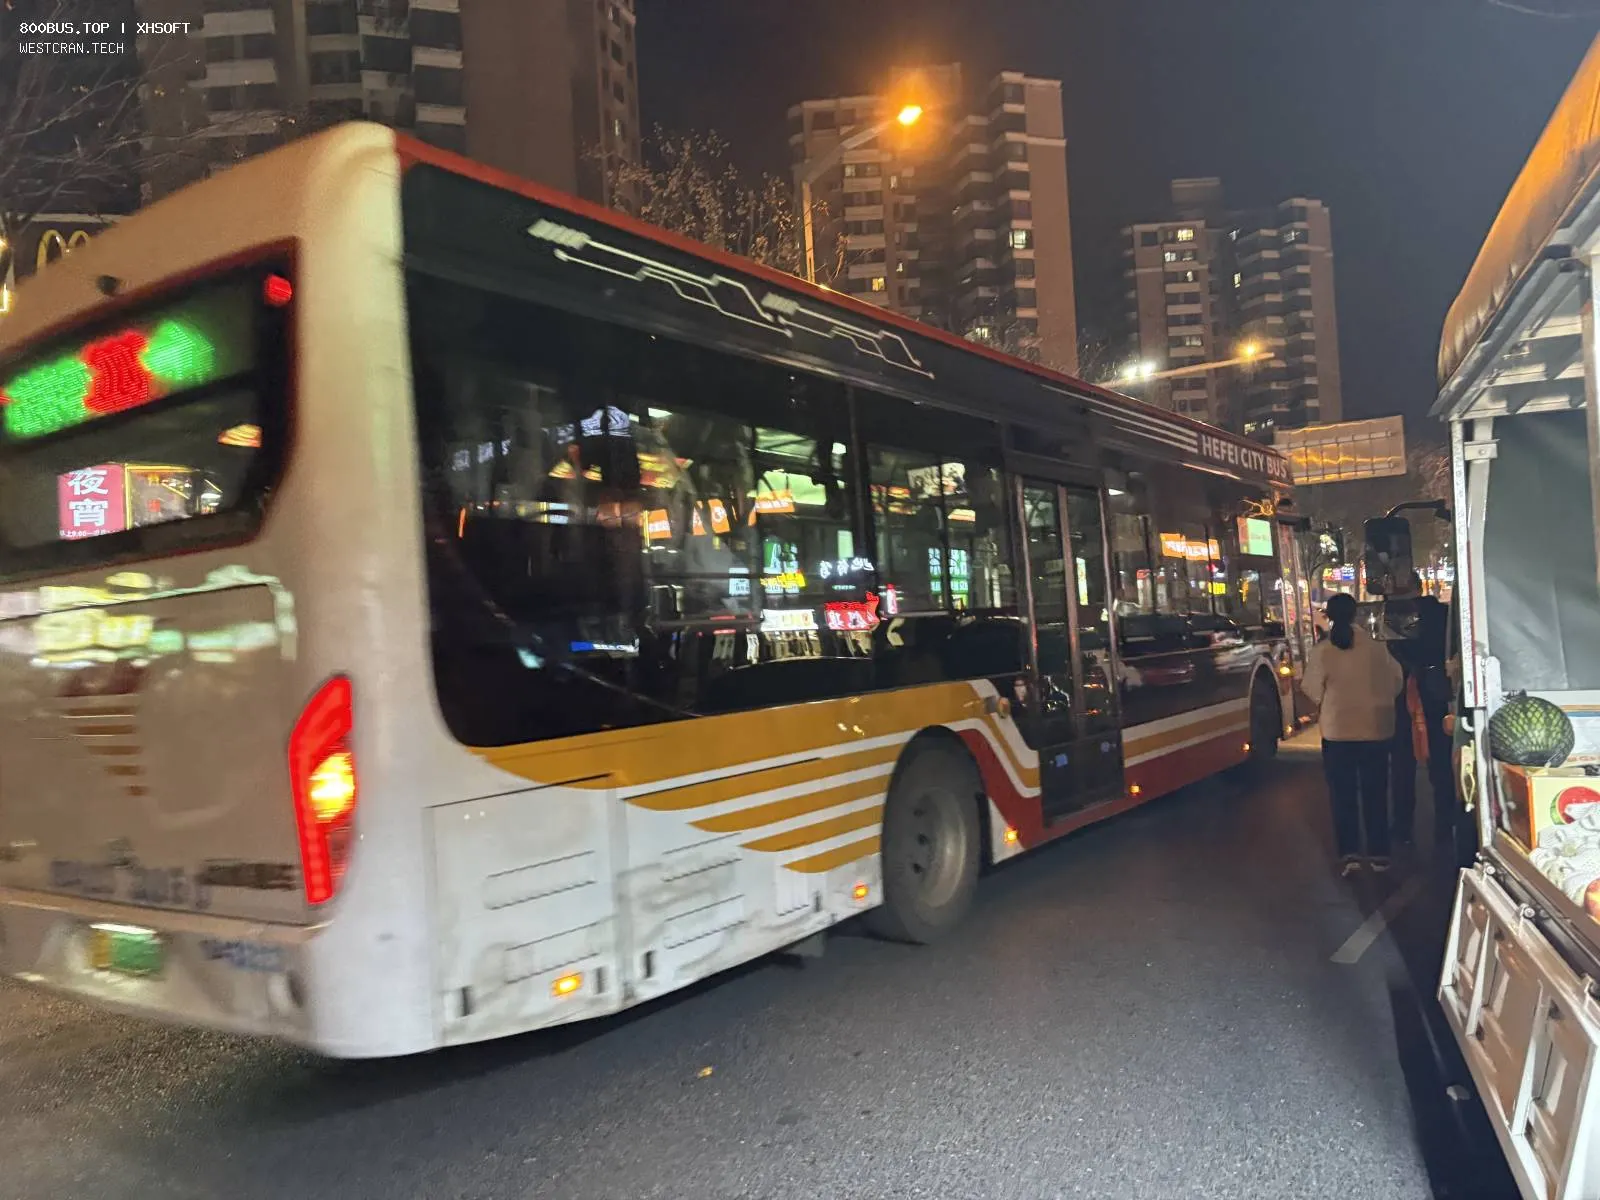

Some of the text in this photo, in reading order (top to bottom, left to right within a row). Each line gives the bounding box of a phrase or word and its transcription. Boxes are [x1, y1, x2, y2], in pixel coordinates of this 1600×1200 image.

[1201, 434, 1288, 479] HEFEI CITY BUS
[67, 467, 109, 527] 夜宵
